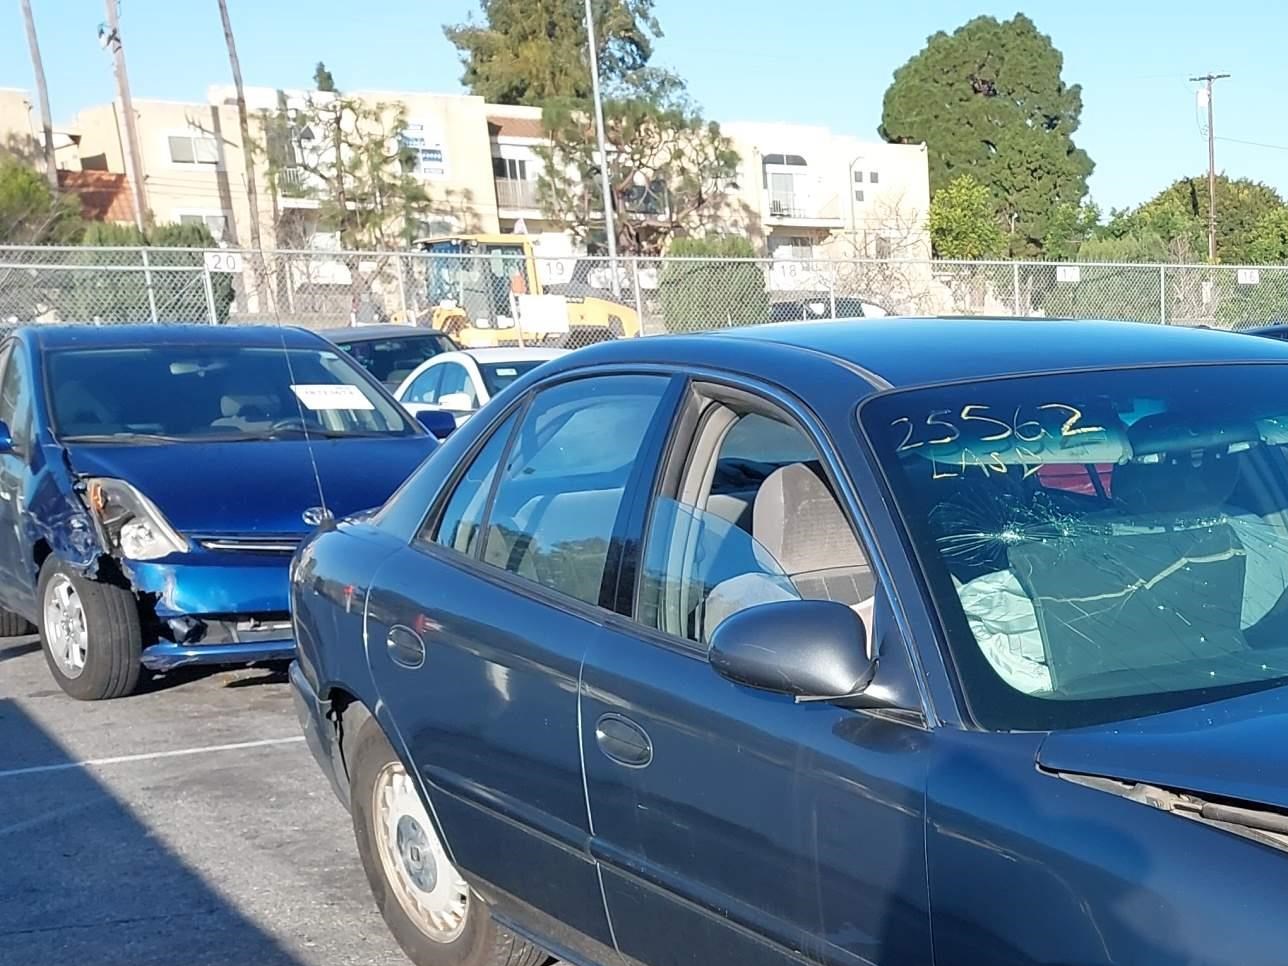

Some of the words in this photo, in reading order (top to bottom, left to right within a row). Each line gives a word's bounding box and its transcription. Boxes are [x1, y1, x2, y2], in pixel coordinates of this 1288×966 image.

[212, 254, 236, 270] 20
[546, 261, 565, 277] 19
[781, 264, 797, 278] 18
[890, 403, 1105, 452] 25562
